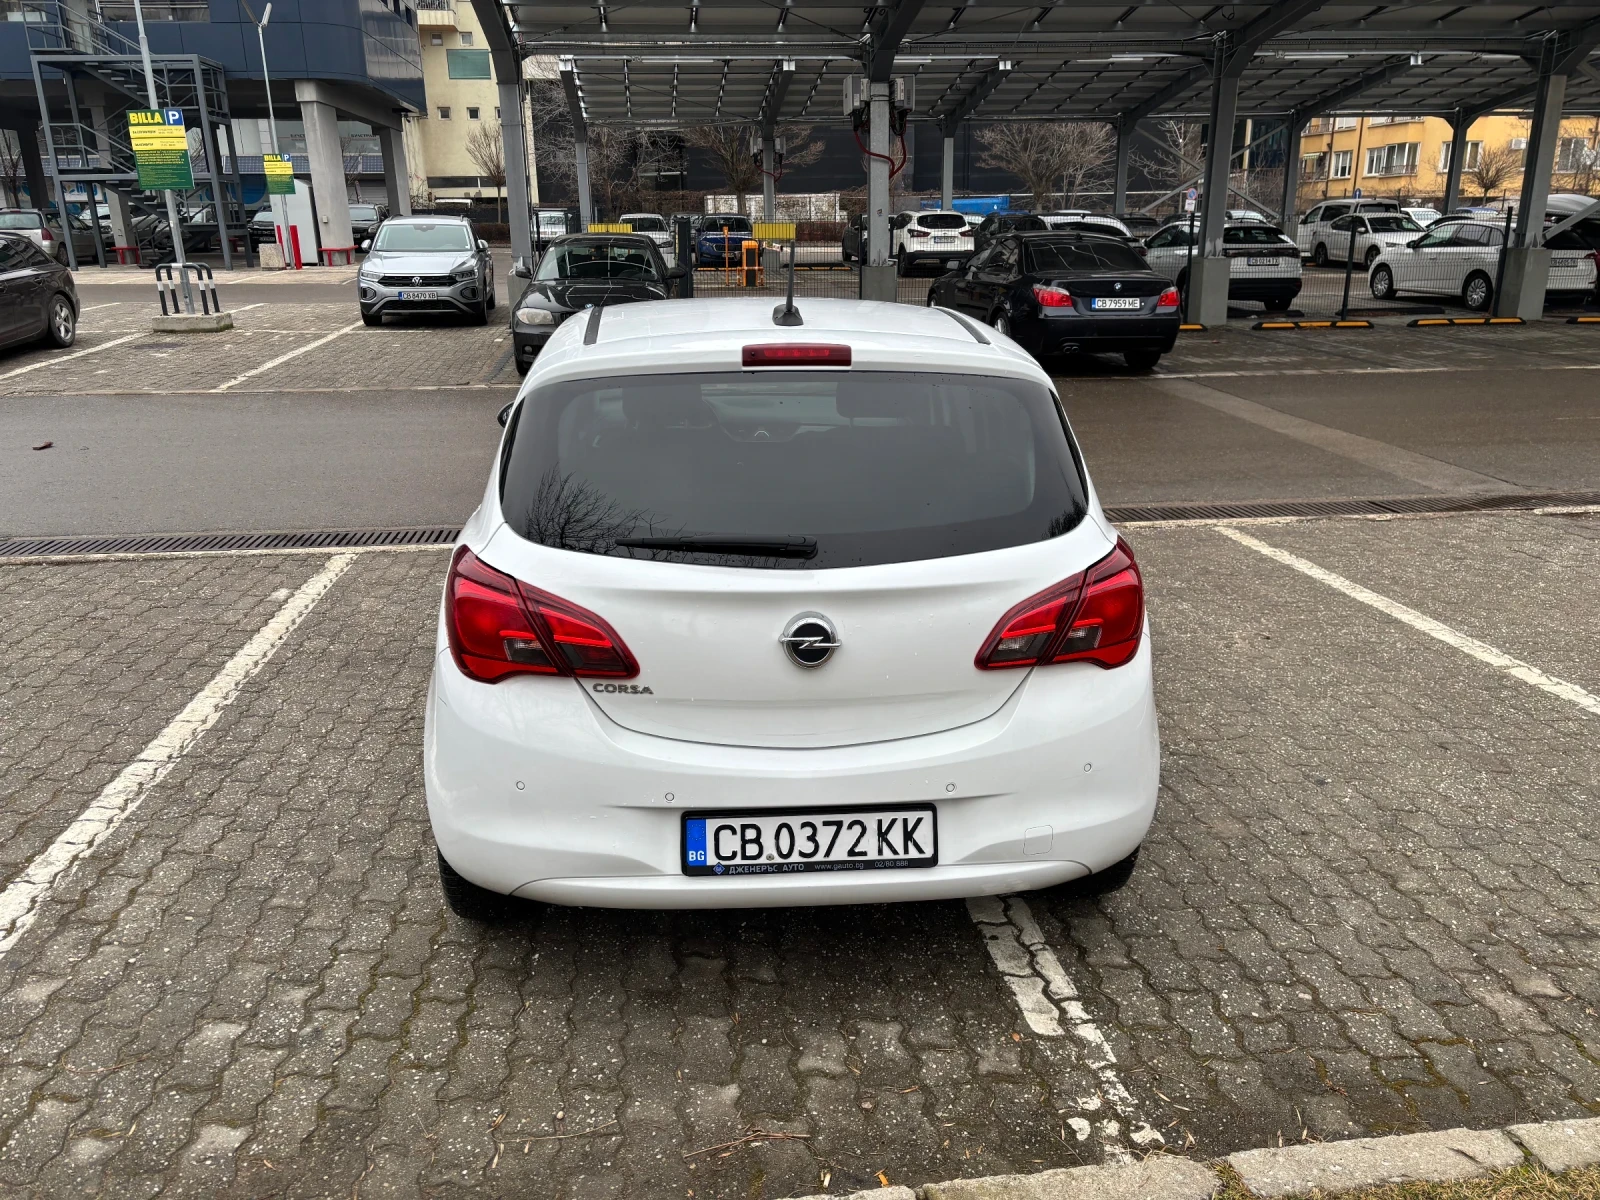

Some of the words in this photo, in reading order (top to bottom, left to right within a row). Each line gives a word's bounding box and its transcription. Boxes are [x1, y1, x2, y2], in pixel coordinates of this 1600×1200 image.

[129, 112, 163, 124] BILLA
[168, 110, 179, 124] P
[1096, 299, 1107, 307] CB
[1108, 299, 1127, 307] 7959
[1128, 299, 1138, 307] ME
[592, 682, 654, 695] CORSA
[688, 850, 705, 861] BG
[728, 863, 778, 875] ДЖЕНЕРЪС
[782, 863, 805, 872] АУТО
[814, 862, 864, 871] www.gauto.bg
